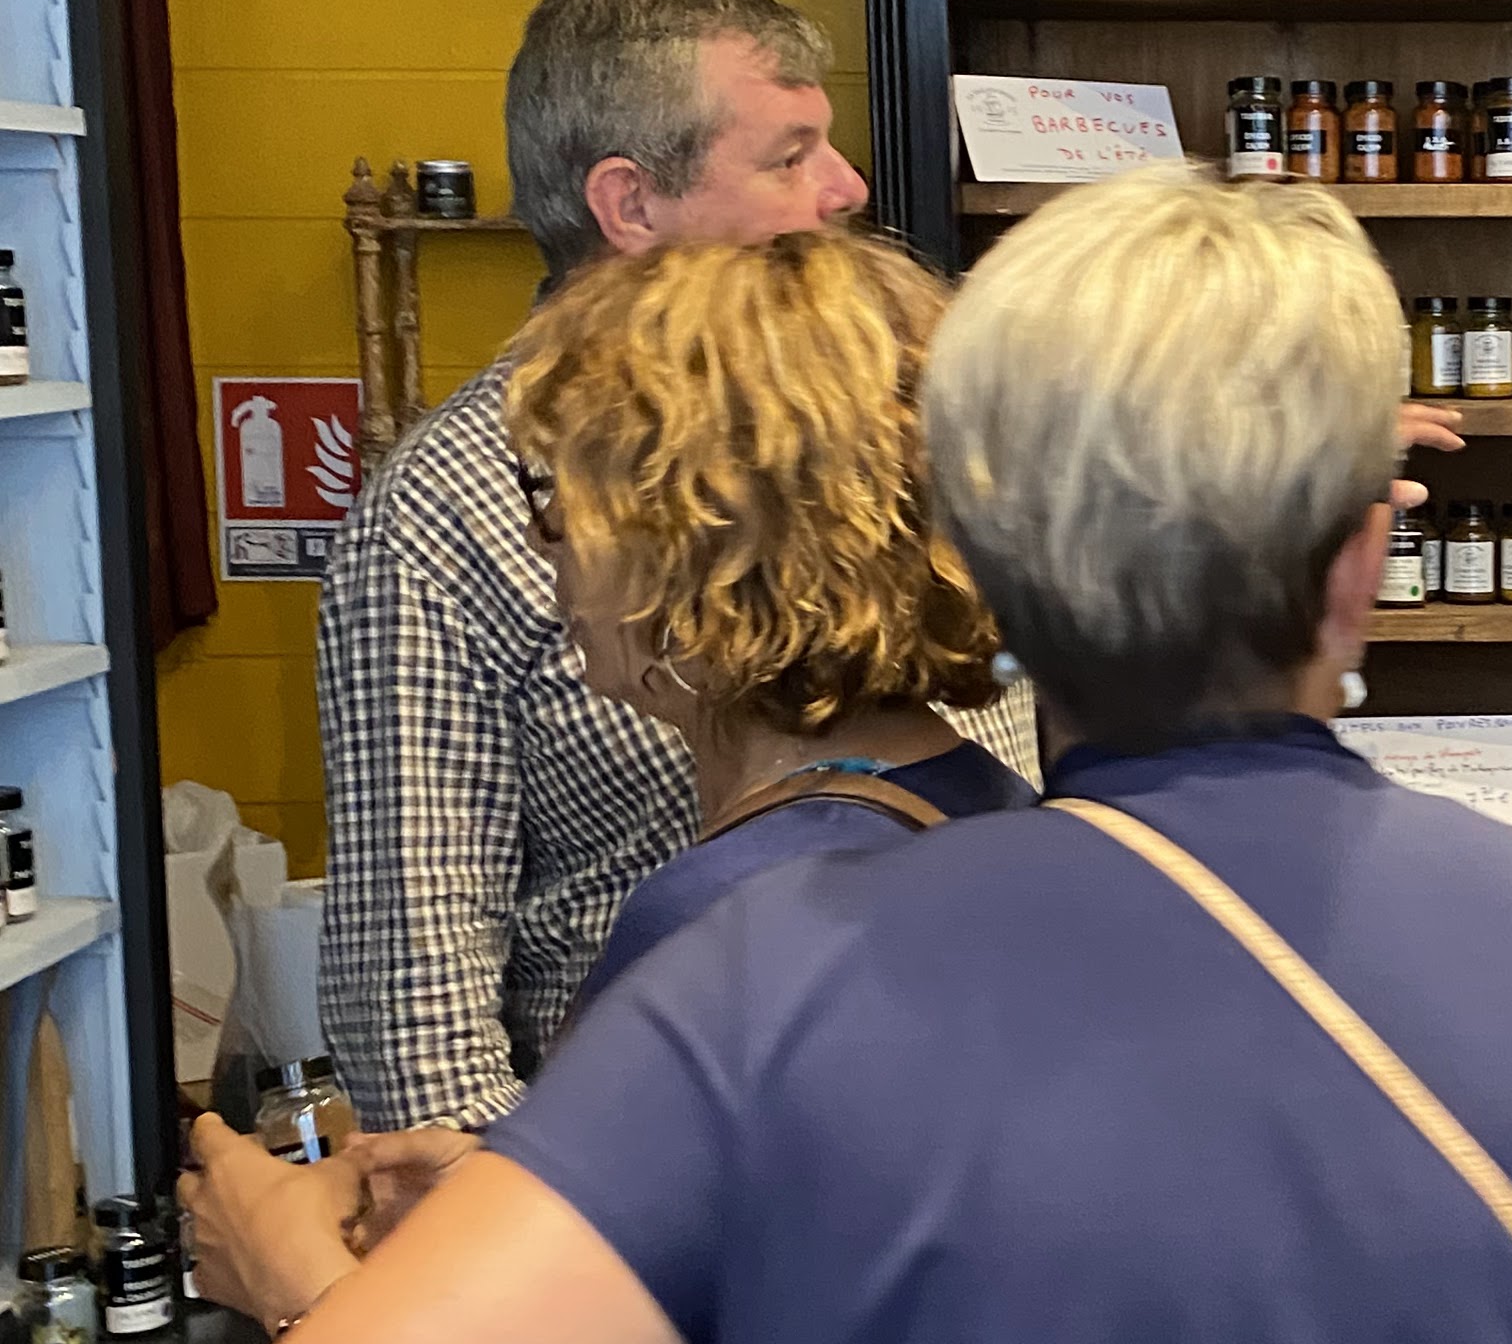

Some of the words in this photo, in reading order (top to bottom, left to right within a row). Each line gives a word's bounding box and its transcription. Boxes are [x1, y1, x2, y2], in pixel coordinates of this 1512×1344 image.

[1027, 85, 1076, 100] POUR
[1101, 90, 1134, 105] VOS
[1032, 114, 1168, 137] BARBECUES
[1056, 147, 1084, 161] DE
